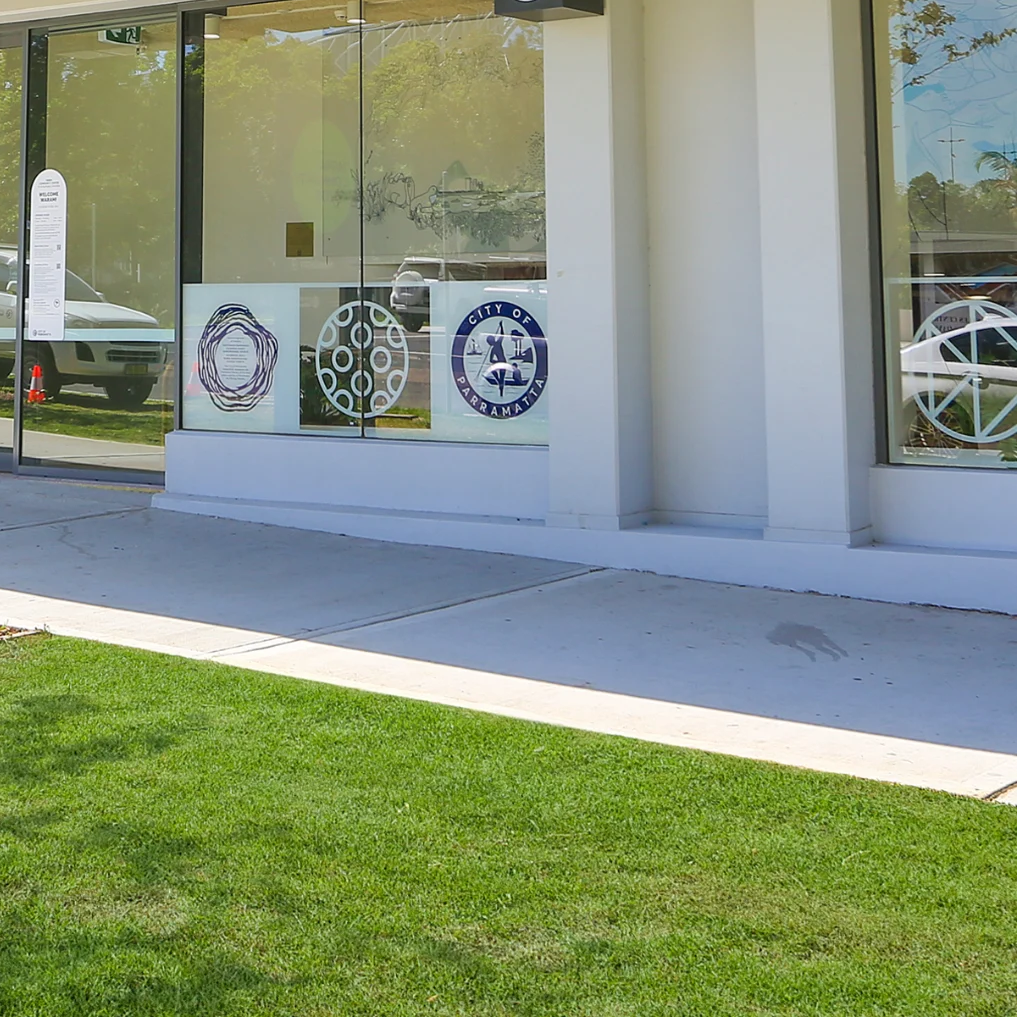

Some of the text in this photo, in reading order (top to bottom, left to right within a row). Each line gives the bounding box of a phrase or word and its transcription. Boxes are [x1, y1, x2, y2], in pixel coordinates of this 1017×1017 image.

[468, 304, 532, 325] CITY OF
[457, 376, 544, 416] PARRAMATTA
